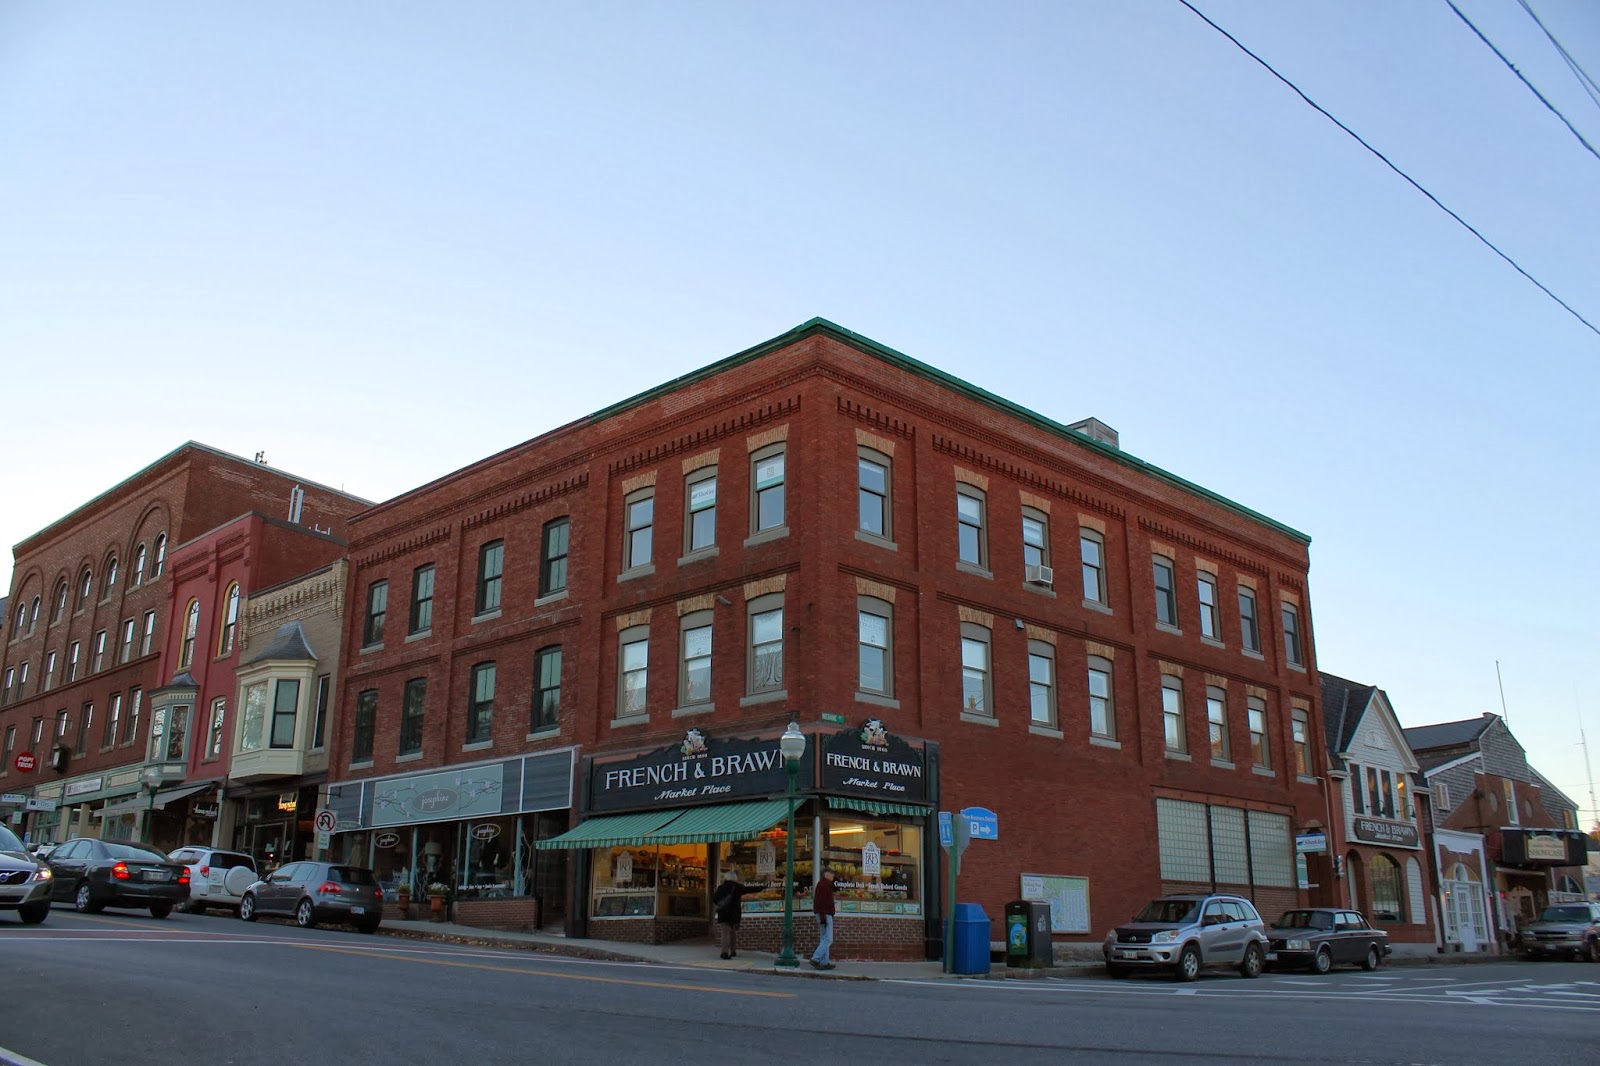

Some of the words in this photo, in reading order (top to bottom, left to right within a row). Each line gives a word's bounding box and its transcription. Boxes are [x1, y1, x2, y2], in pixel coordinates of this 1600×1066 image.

[826, 753, 870, 771] FRENCH
[873, 761, 880, 773] &
[882, 761, 921, 778] BRAWN
[605, 762, 687, 790] FRENCH
[694, 762, 706, 779] &
[654, 787, 697, 800] Market
[701, 784, 731, 795] Place
[842, 777, 878, 789] Market
[882, 782, 906, 792] Place
[421, 790, 449, 809] josephine
[972, 823, 978, 832] P
[1360, 821, 1385, 833] FRENCH
[834, 881, 855, 889] Complete
